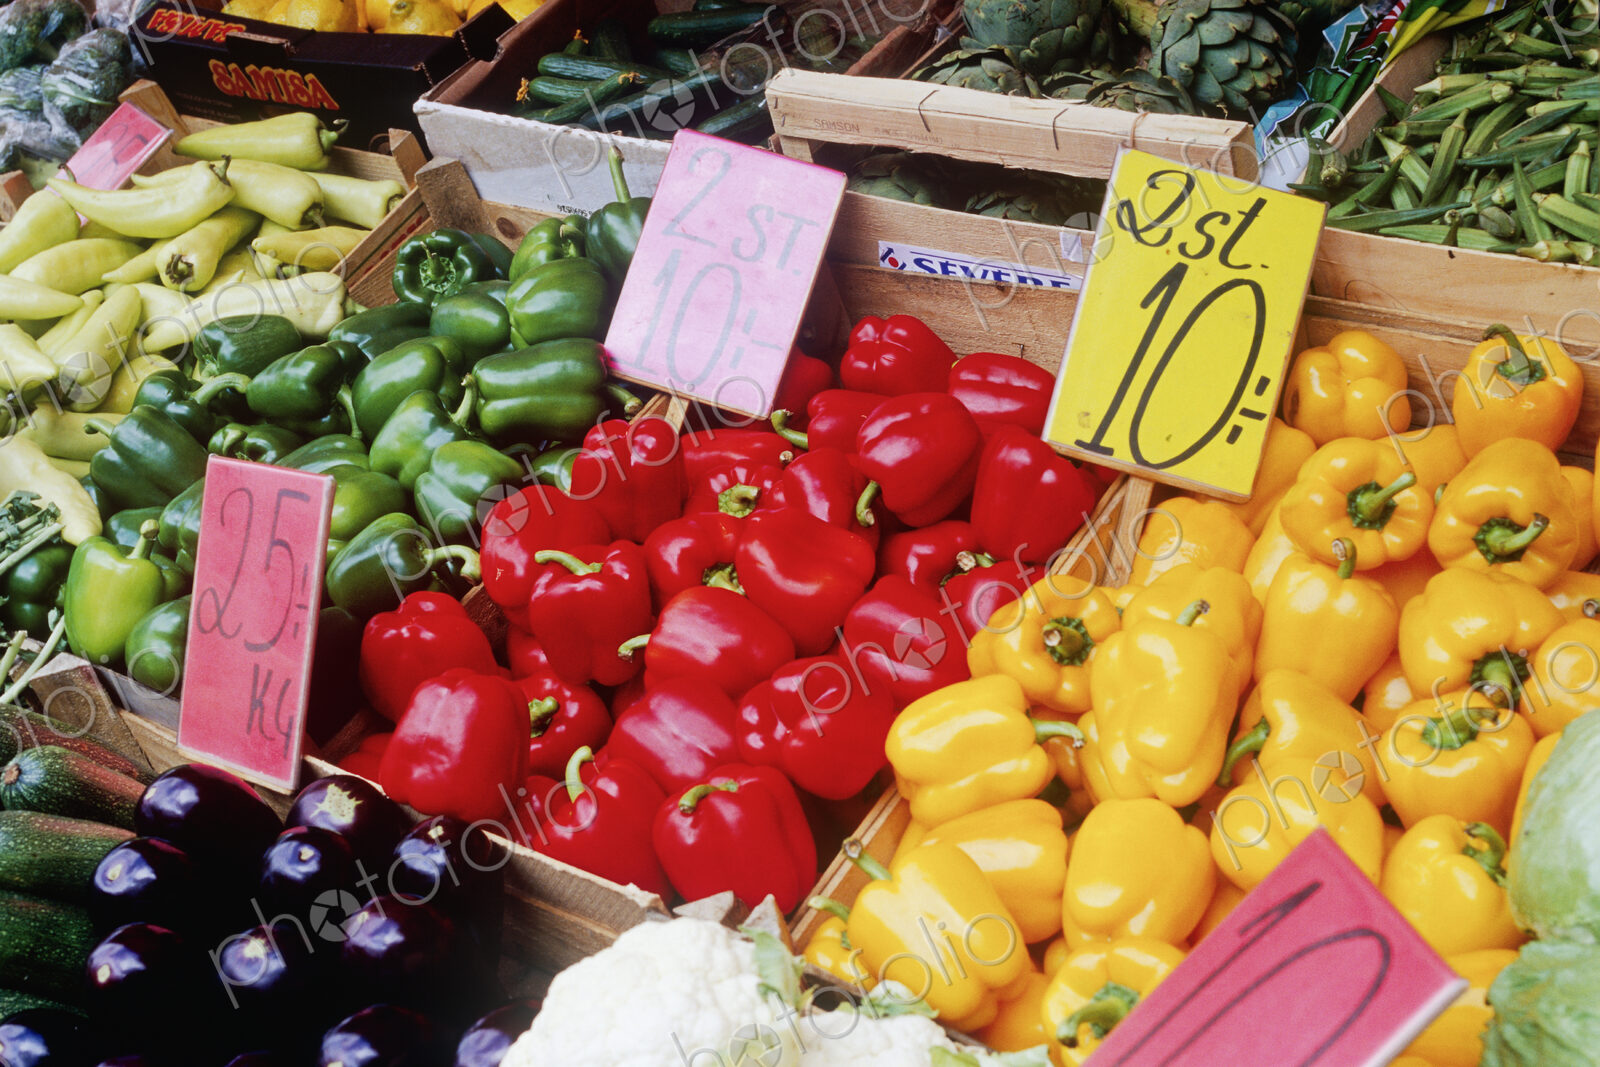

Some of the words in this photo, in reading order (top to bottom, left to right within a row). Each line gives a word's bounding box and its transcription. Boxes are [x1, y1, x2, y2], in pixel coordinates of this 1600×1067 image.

[208, 58, 340, 111] SAMISA
[814, 118, 860, 134] SAMSON
[661, 146, 722, 248] 2
[1115, 169, 1196, 248] 2
